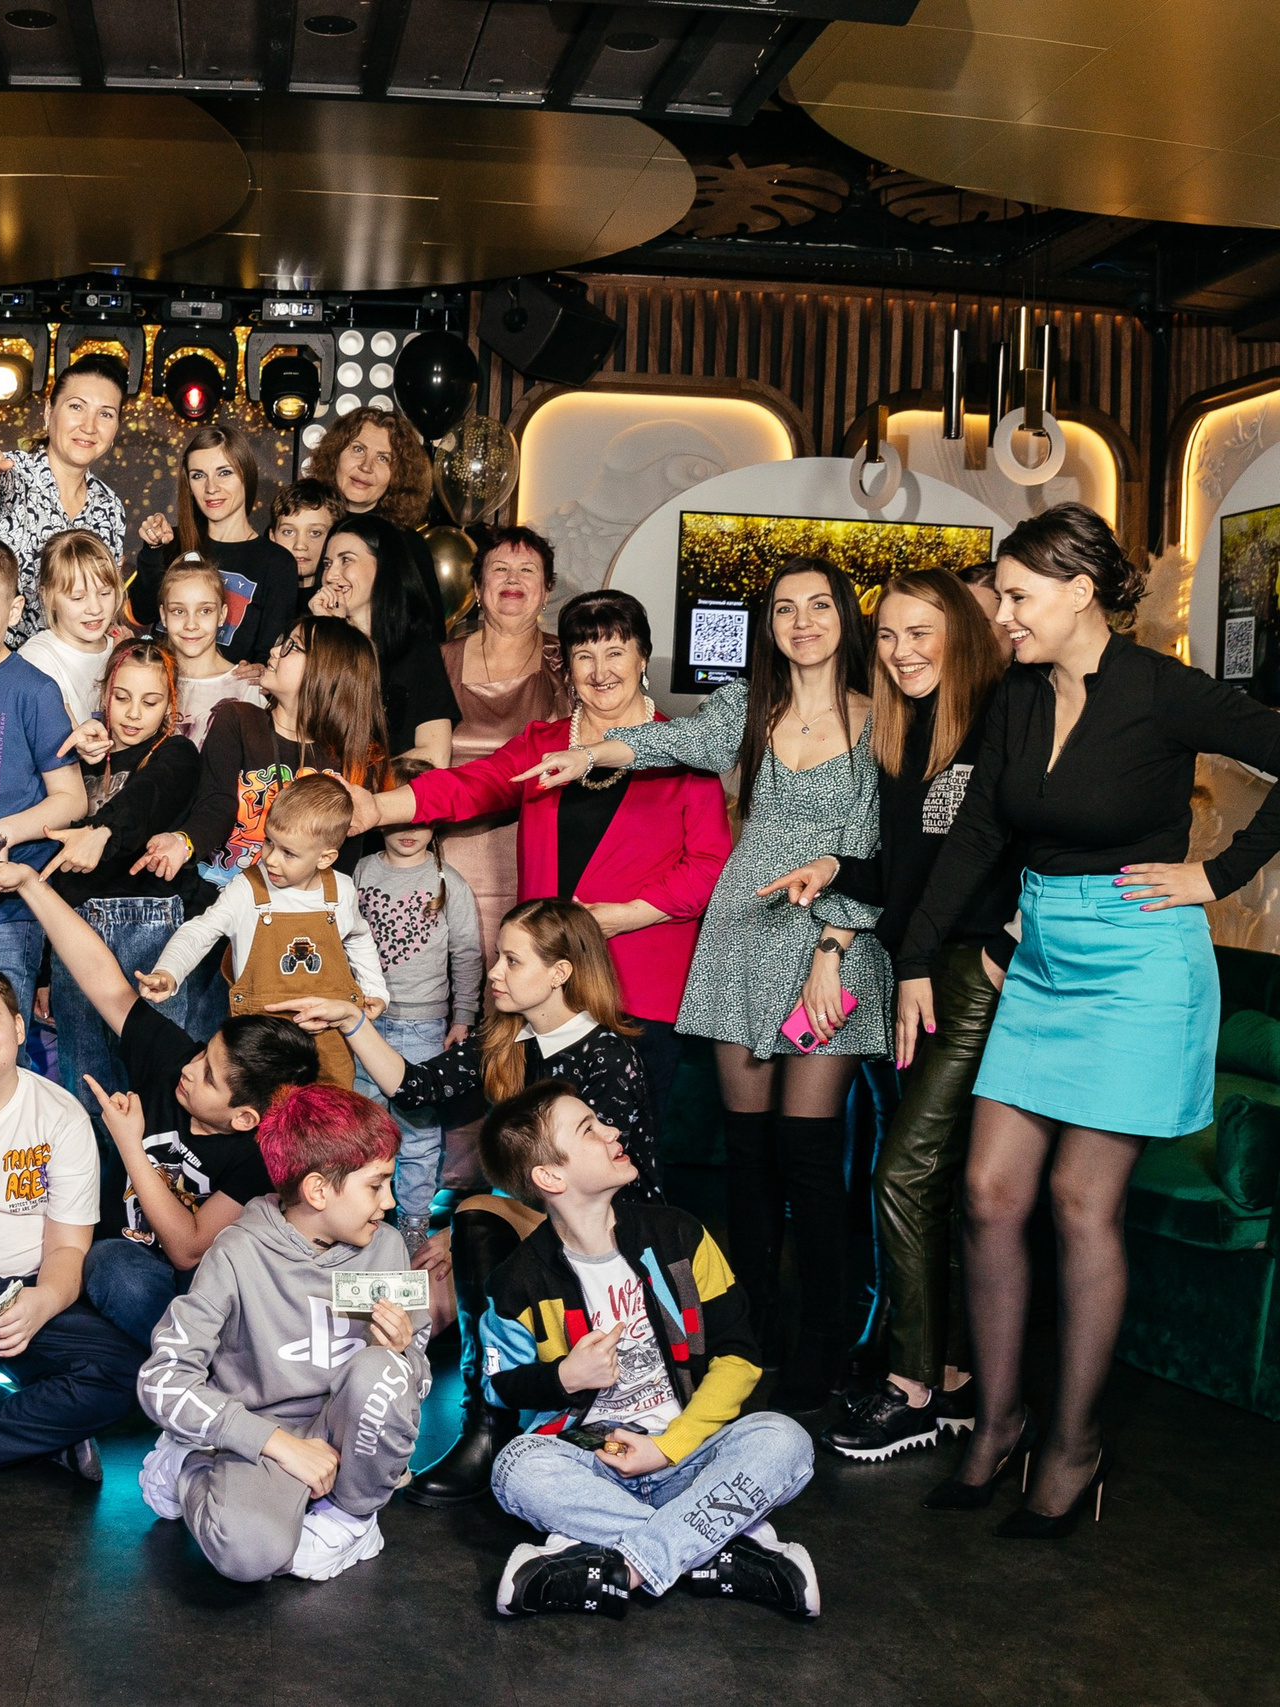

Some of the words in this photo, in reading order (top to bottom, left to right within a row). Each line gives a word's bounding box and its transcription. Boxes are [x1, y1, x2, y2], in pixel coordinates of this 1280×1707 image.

[955, 770, 970, 778] NOT
[924, 798, 944, 806] BLACK
[5, 1167, 45, 1202] AGE
[643, 1393, 665, 1409] LIVE
[731, 1471, 770, 1512] BELIEVE
